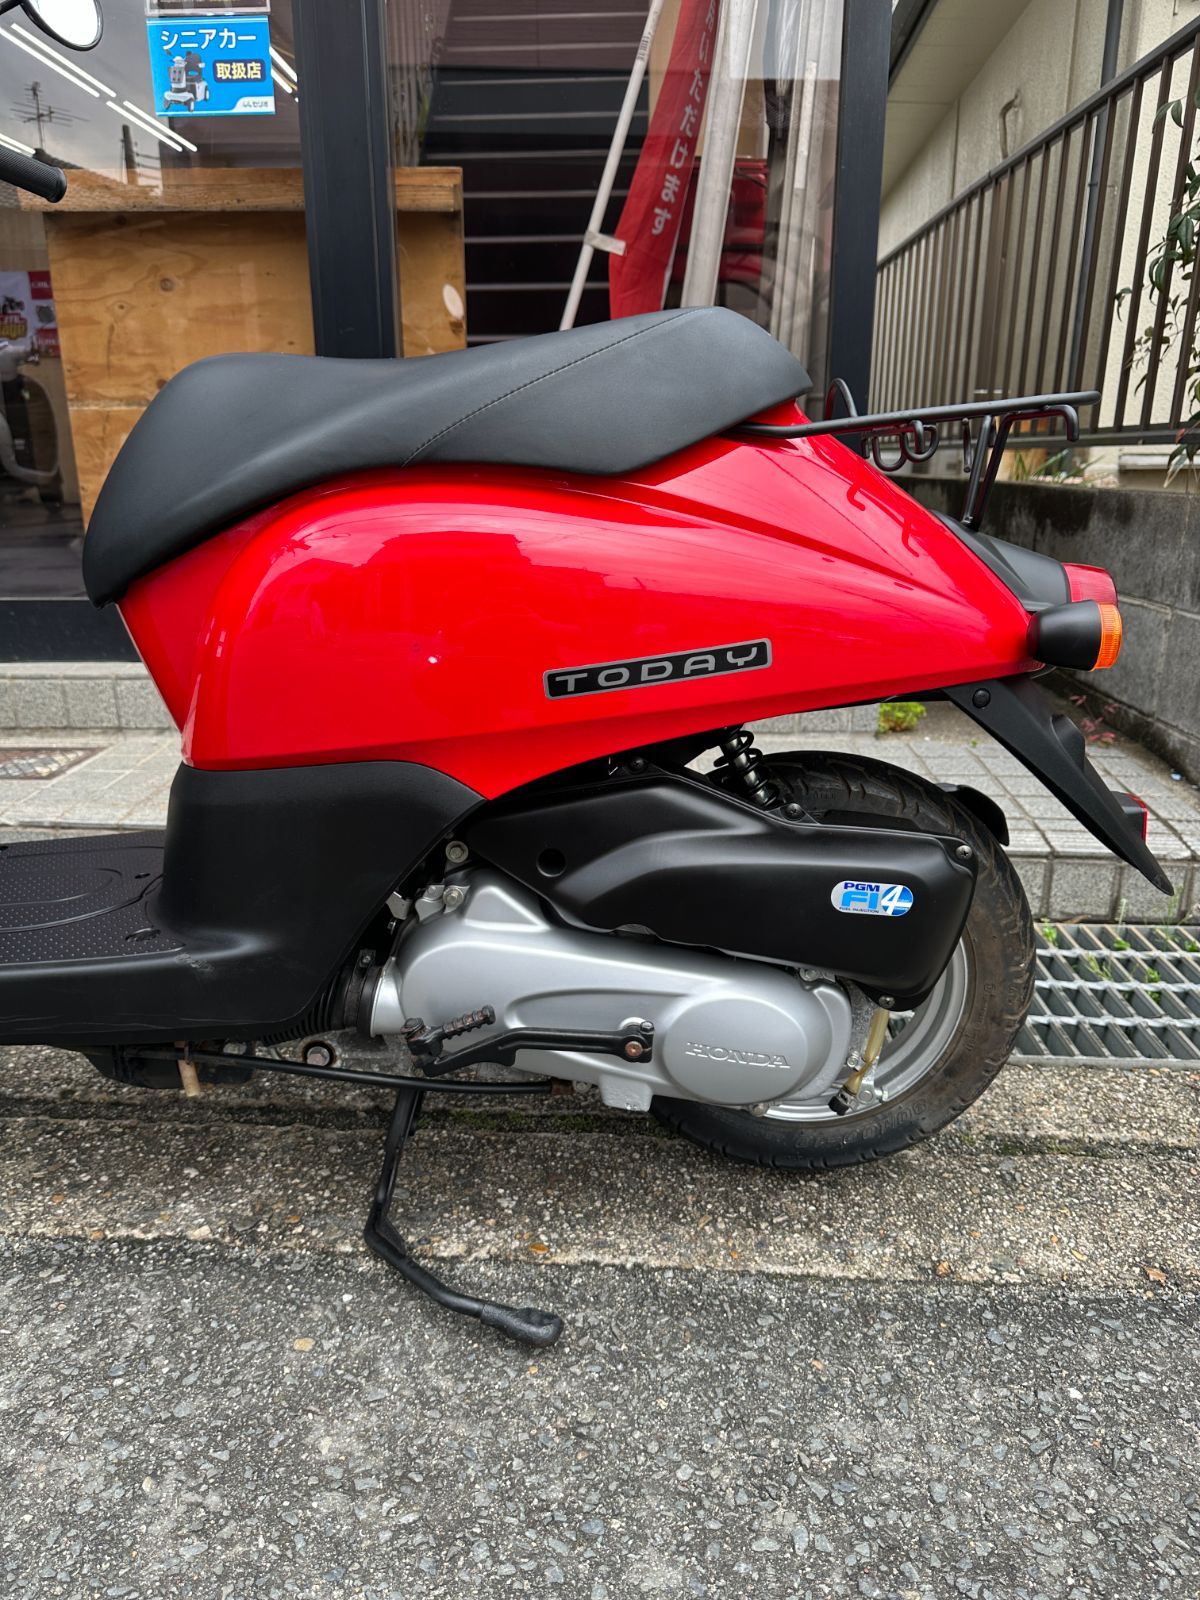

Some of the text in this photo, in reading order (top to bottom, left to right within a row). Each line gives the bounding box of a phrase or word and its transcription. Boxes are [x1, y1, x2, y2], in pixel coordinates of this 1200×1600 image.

[161, 28, 256, 50] シニアカー
[216, 62, 262, 79] 取扱店
[555, 647, 757, 692] TODAY
[843, 882, 880, 892] PGM
[685, 1042, 790, 1069] HONDA
